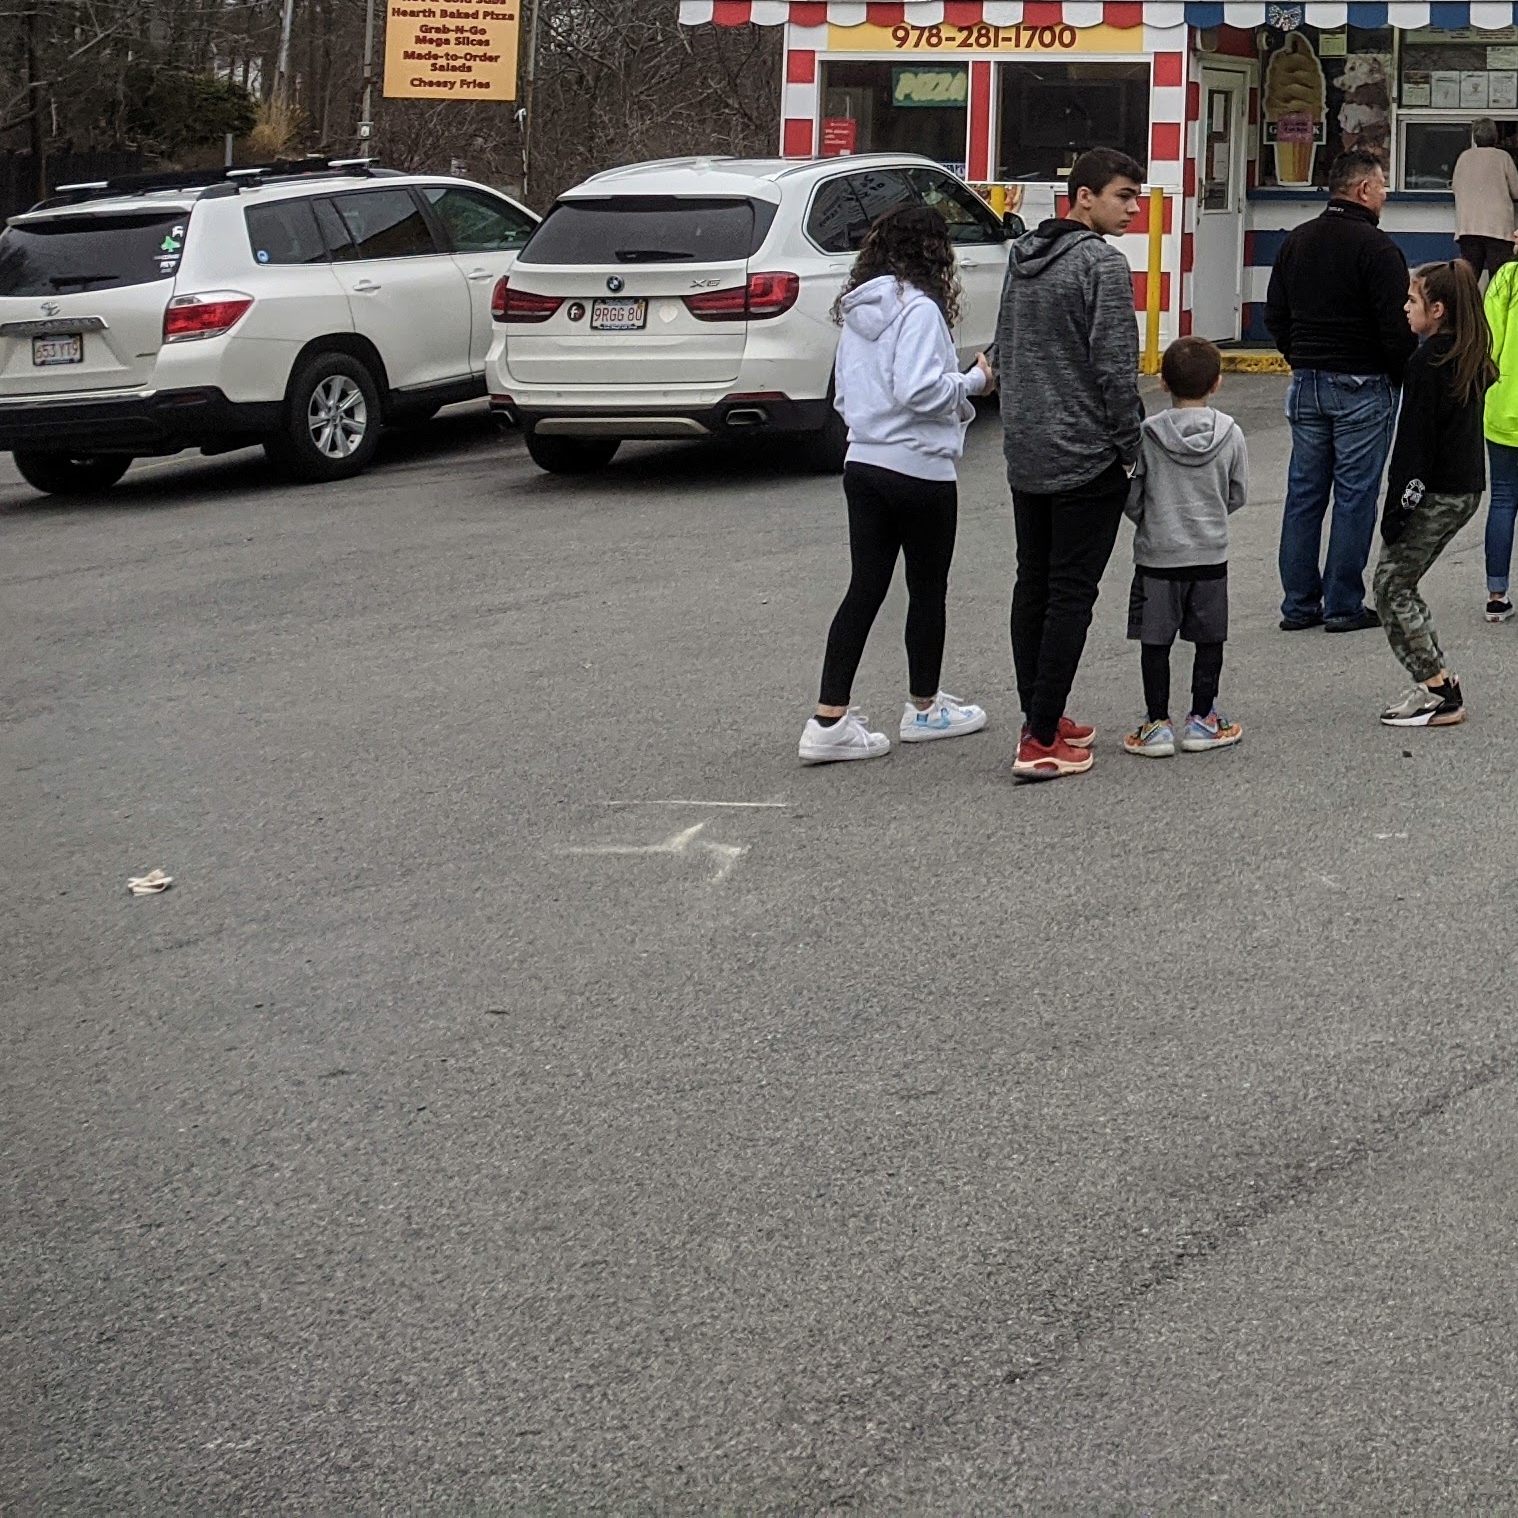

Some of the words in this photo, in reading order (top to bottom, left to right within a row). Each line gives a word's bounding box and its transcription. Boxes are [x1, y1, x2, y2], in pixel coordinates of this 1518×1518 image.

[391, 7, 436, 19] Hearth
[440, 9, 479, 20] Baked
[482, 10, 515, 21] Pizza
[419, 24, 487, 36] Grab-N-Go
[892, 24, 1077, 49] 978-281-1700
[415, 35, 451, 48] Mega
[454, 36, 490, 47] Slices
[403, 50, 501, 63] Made-to-Order
[430, 63, 472, 73] Salads
[410, 77, 456, 90] Cheesy
[459, 79, 491, 89] Fries
[594, 307, 625, 322] 9RGG
